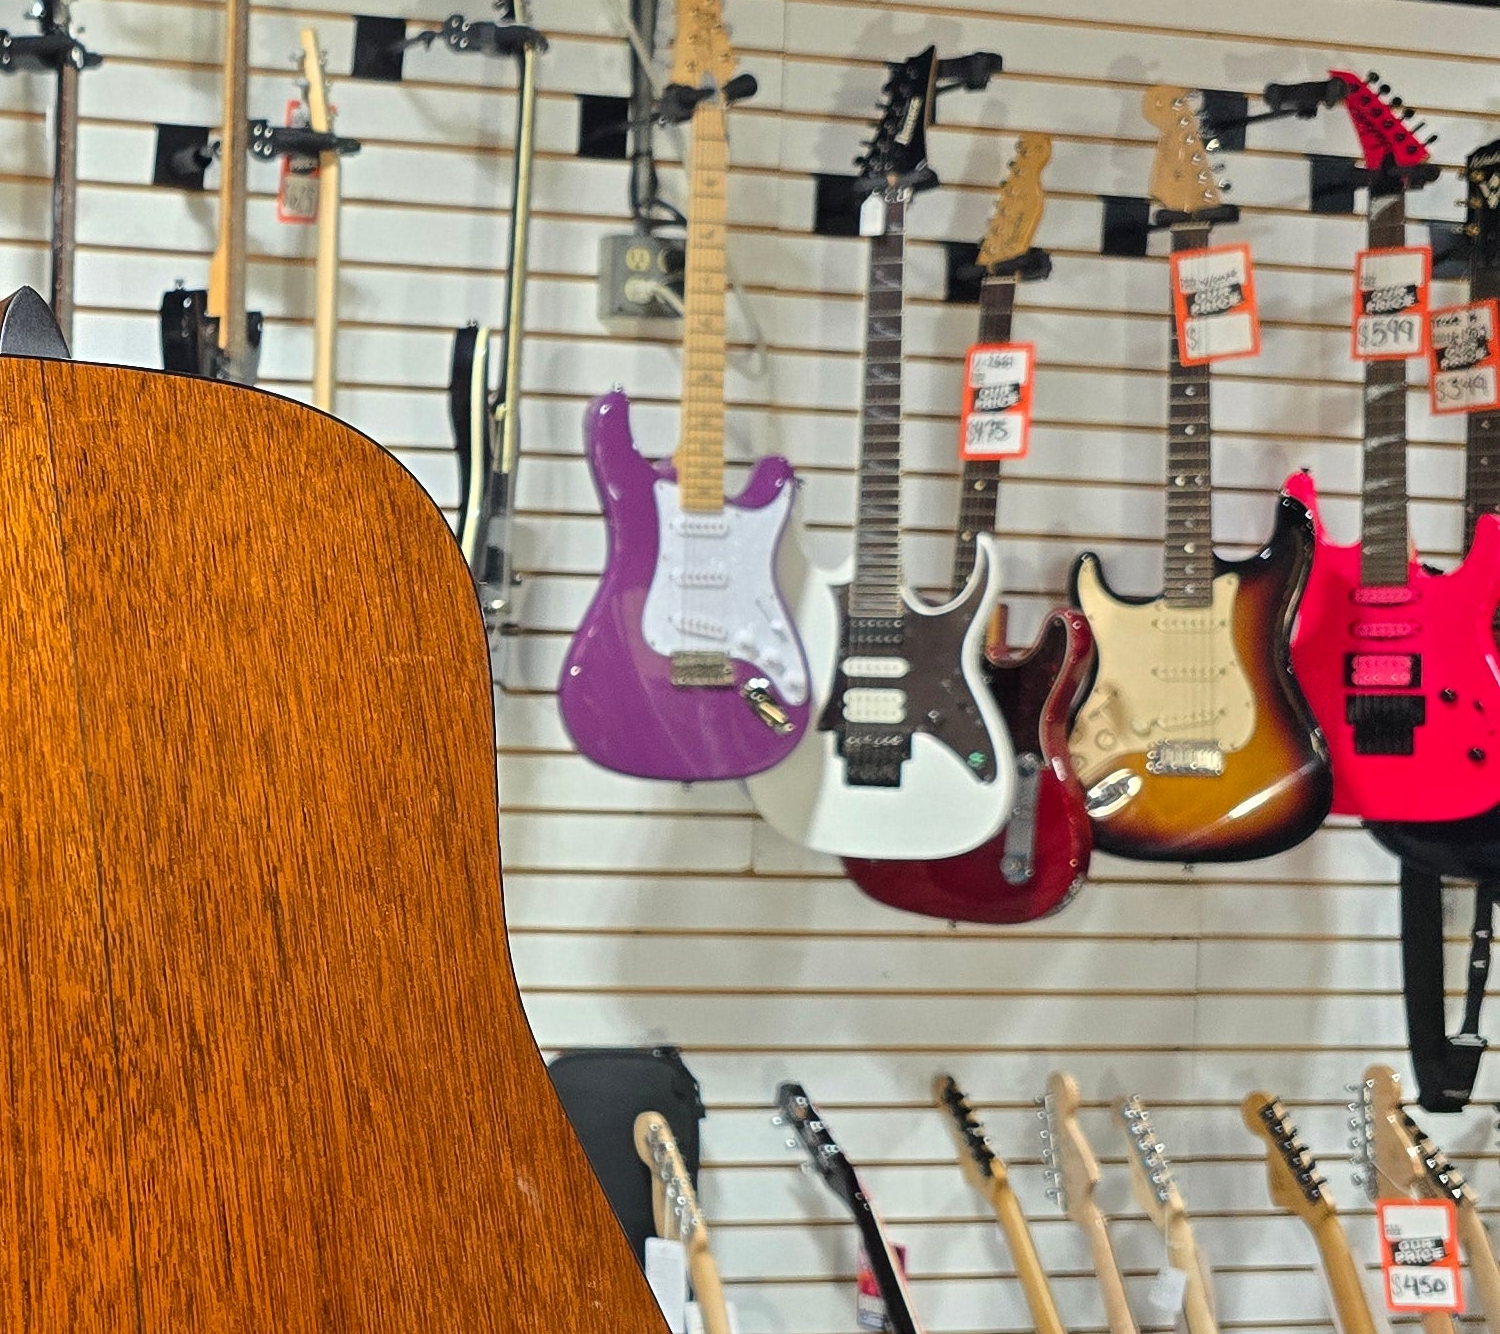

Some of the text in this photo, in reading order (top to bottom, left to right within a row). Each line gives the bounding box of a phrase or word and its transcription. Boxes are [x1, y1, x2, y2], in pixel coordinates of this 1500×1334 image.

[1195, 286, 1233, 304] OUR
[1370, 286, 1409, 302] OUR
[1190, 294, 1243, 315] PRICE
[1365, 295, 1417, 314] PRICE
[1357, 317, 1416, 349] $599
[979, 384, 1015, 399] OUR
[1436, 373, 1489, 404] $349
[974, 394, 1021, 411] PRICE
[1398, 1239, 1435, 1252] OUR
[1394, 1247, 1446, 1265] PRICE
[1391, 1274, 1446, 1296] $450
